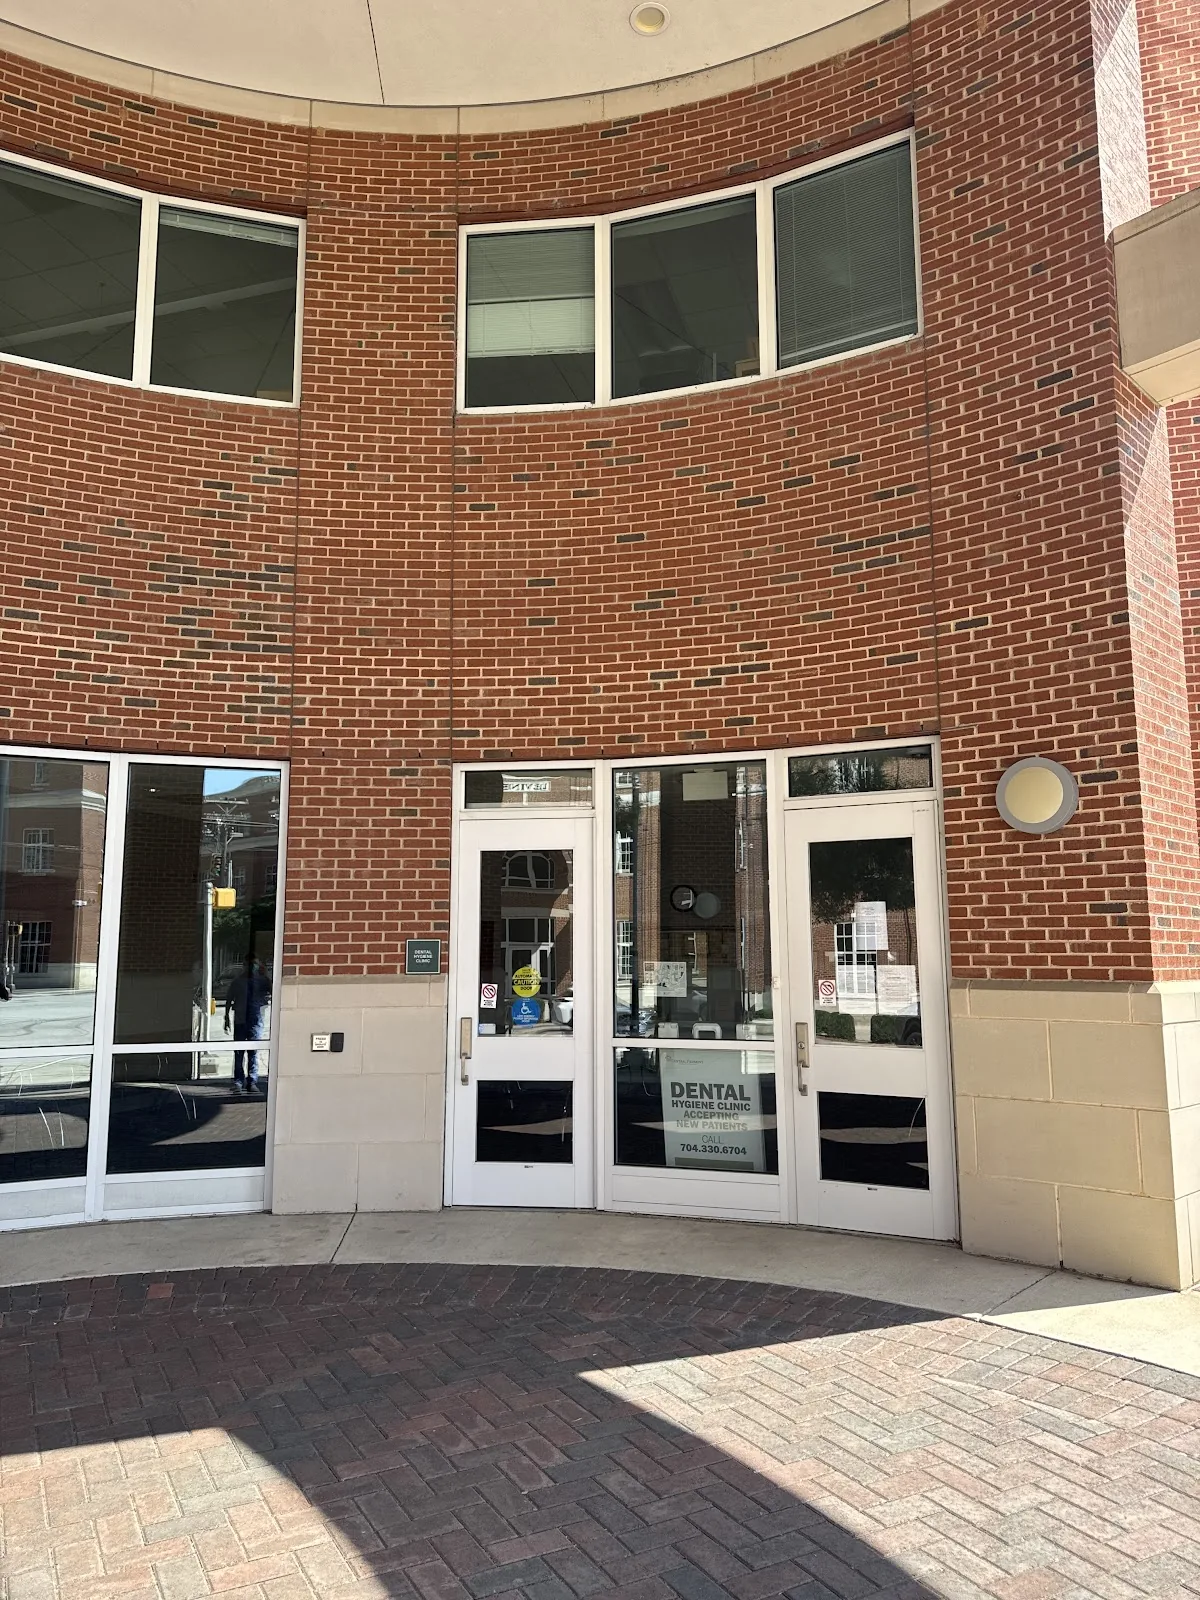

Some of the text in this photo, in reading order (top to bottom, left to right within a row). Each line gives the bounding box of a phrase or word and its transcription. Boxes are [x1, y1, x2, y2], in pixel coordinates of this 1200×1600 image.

[671, 1082, 751, 1101] DENTAL
[672, 1100, 751, 1111] HYGIENE CLINIC
[684, 1111, 739, 1120] ACCEPTING
[677, 1120, 748, 1131] NEW PATIENTS
[702, 1135, 724, 1144] CALL
[680, 1144, 747, 1155] 704.330.6704
